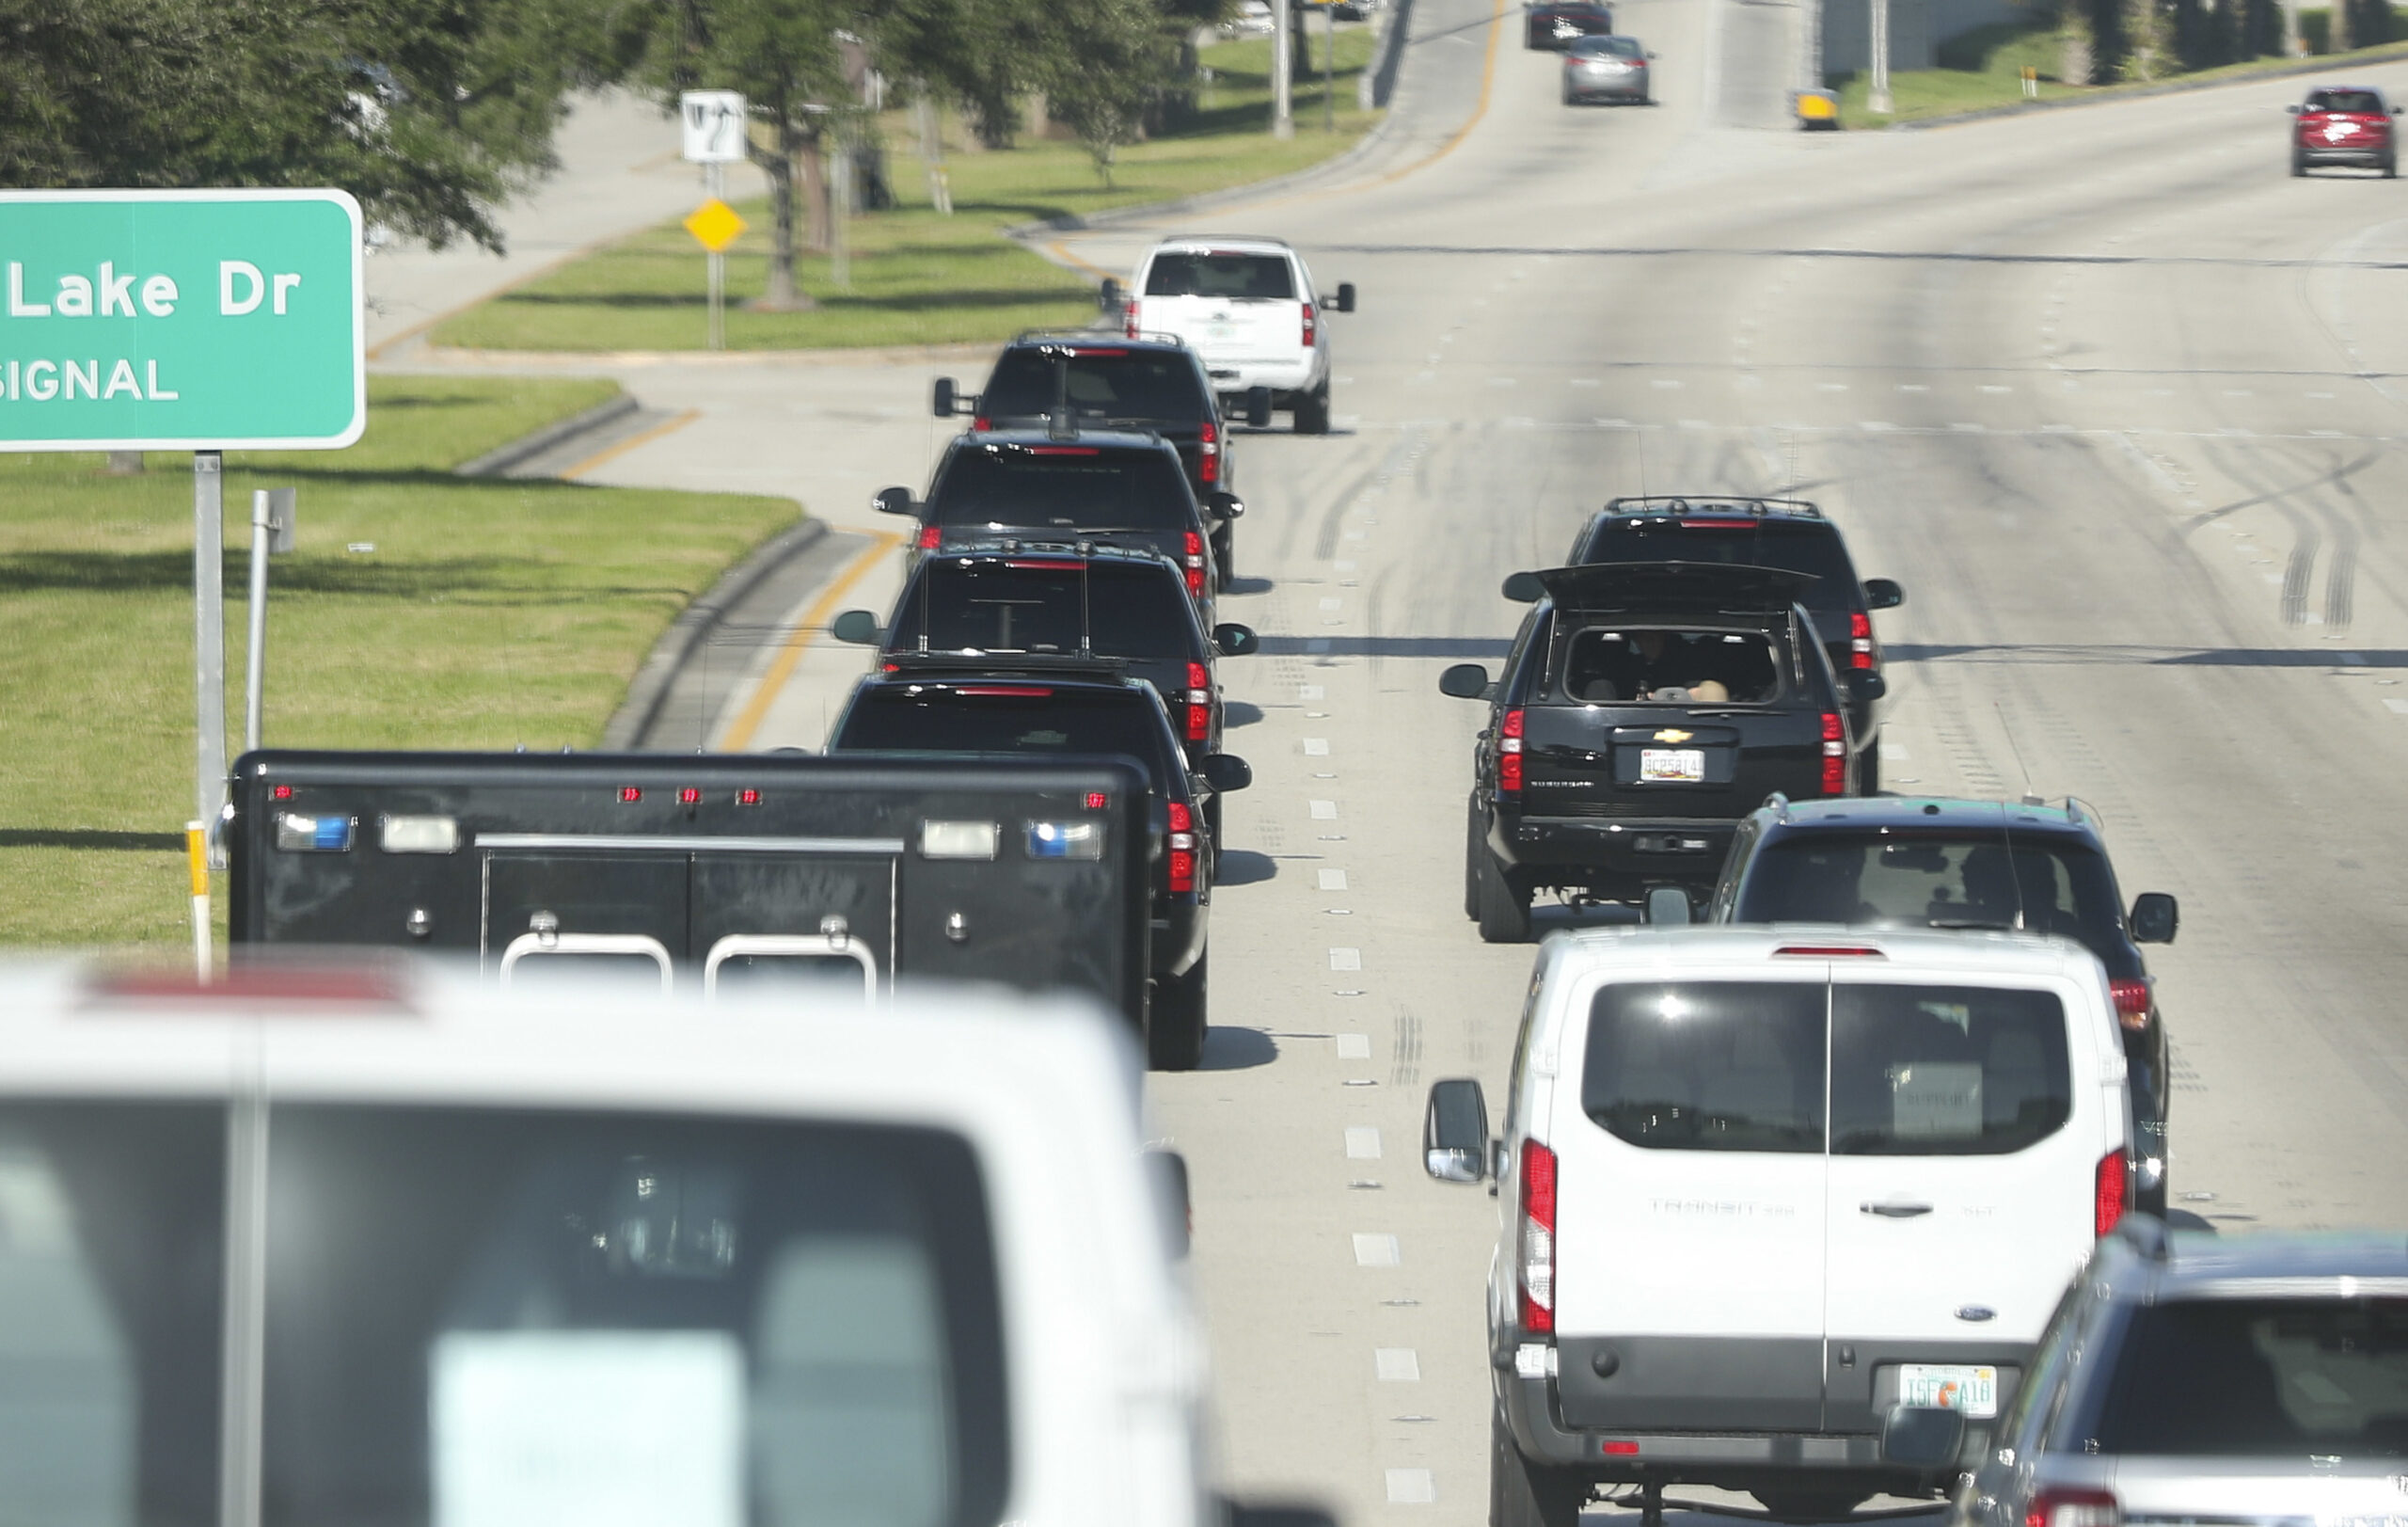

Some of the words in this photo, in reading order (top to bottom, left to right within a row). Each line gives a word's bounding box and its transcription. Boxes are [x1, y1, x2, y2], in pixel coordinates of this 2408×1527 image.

[9, 260, 179, 317] Lake
[219, 260, 301, 316] Dr
[0, 359, 179, 401] IGNAL
[1648, 1198, 1759, 1217] TRANSIT
